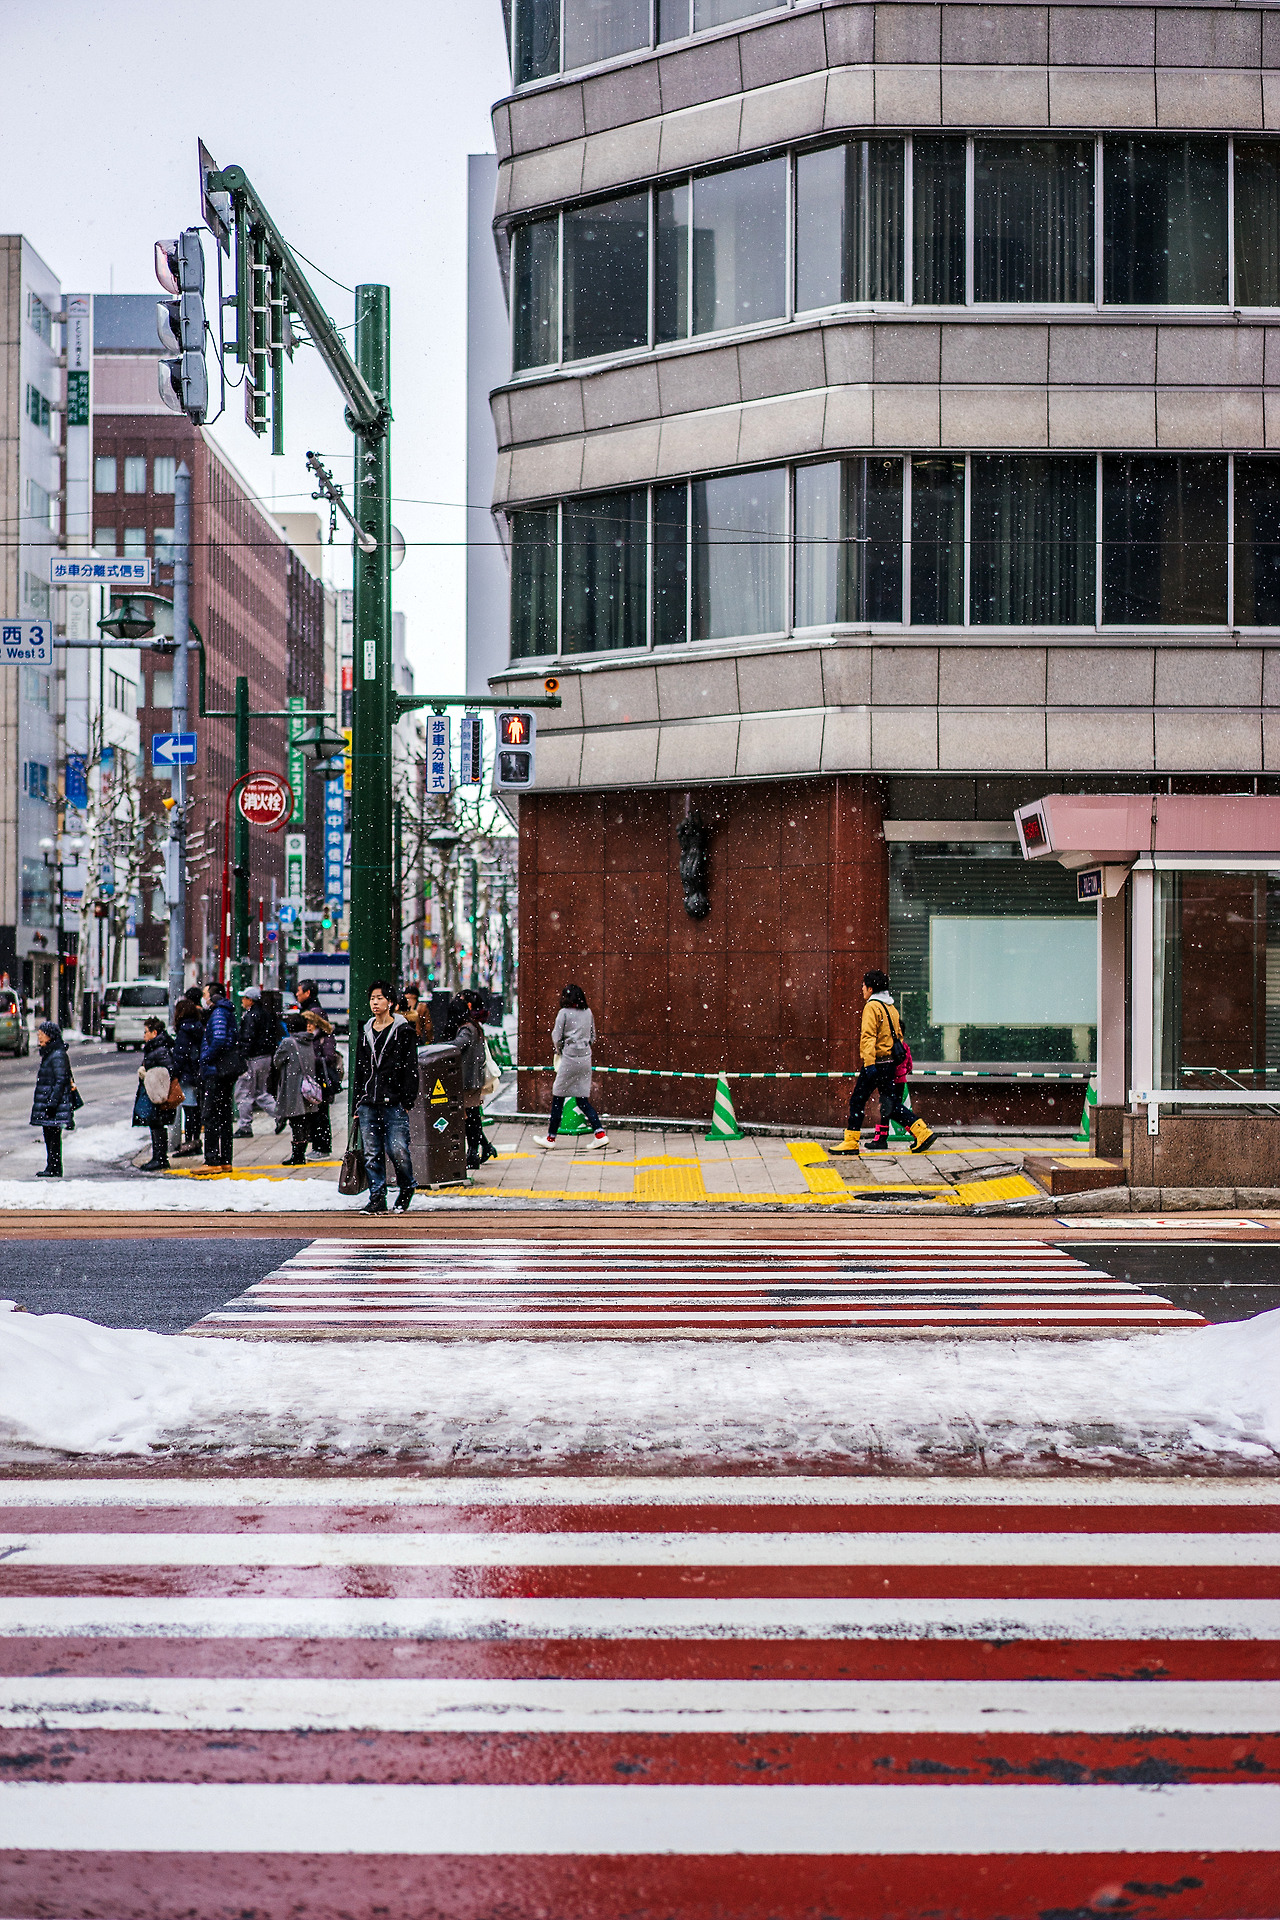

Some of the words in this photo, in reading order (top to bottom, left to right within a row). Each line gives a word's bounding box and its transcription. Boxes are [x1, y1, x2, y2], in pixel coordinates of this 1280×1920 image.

[55, 564, 145, 577] 歩車分離式信号
[7, 648, 35, 659] West
[38, 648, 45, 658] 3
[432, 720, 446, 789] 歩車分離式
[243, 792, 282, 812] 消火栓
